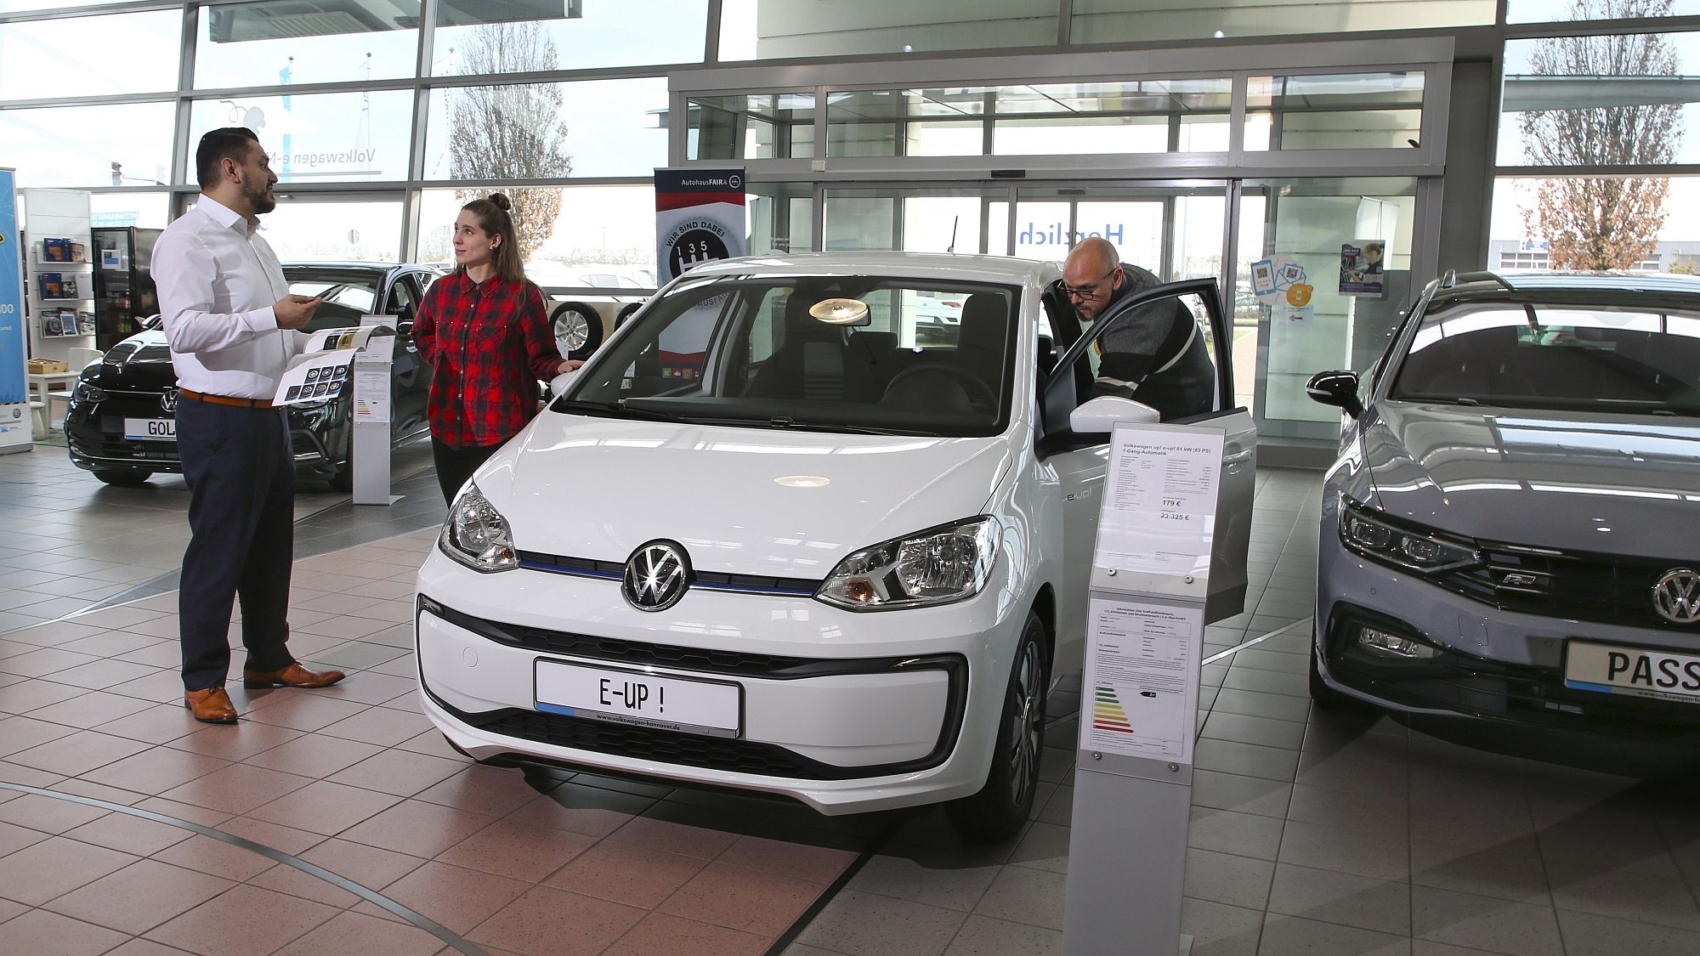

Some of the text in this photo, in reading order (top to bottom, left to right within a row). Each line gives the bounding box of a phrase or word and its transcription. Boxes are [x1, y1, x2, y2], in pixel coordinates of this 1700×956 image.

[666, 221, 725, 247] WIR SIND DABEI
[688, 243, 696, 254] 3
[700, 240, 708, 251] 5
[1163, 499, 1175, 507] 179
[1160, 512, 1184, 521] 23.325
[1608, 651, 1700, 691] PASS
[600, 678, 665, 713] E-UP !
[597, 714, 681, 731] www.volkswagen-hannover.de
